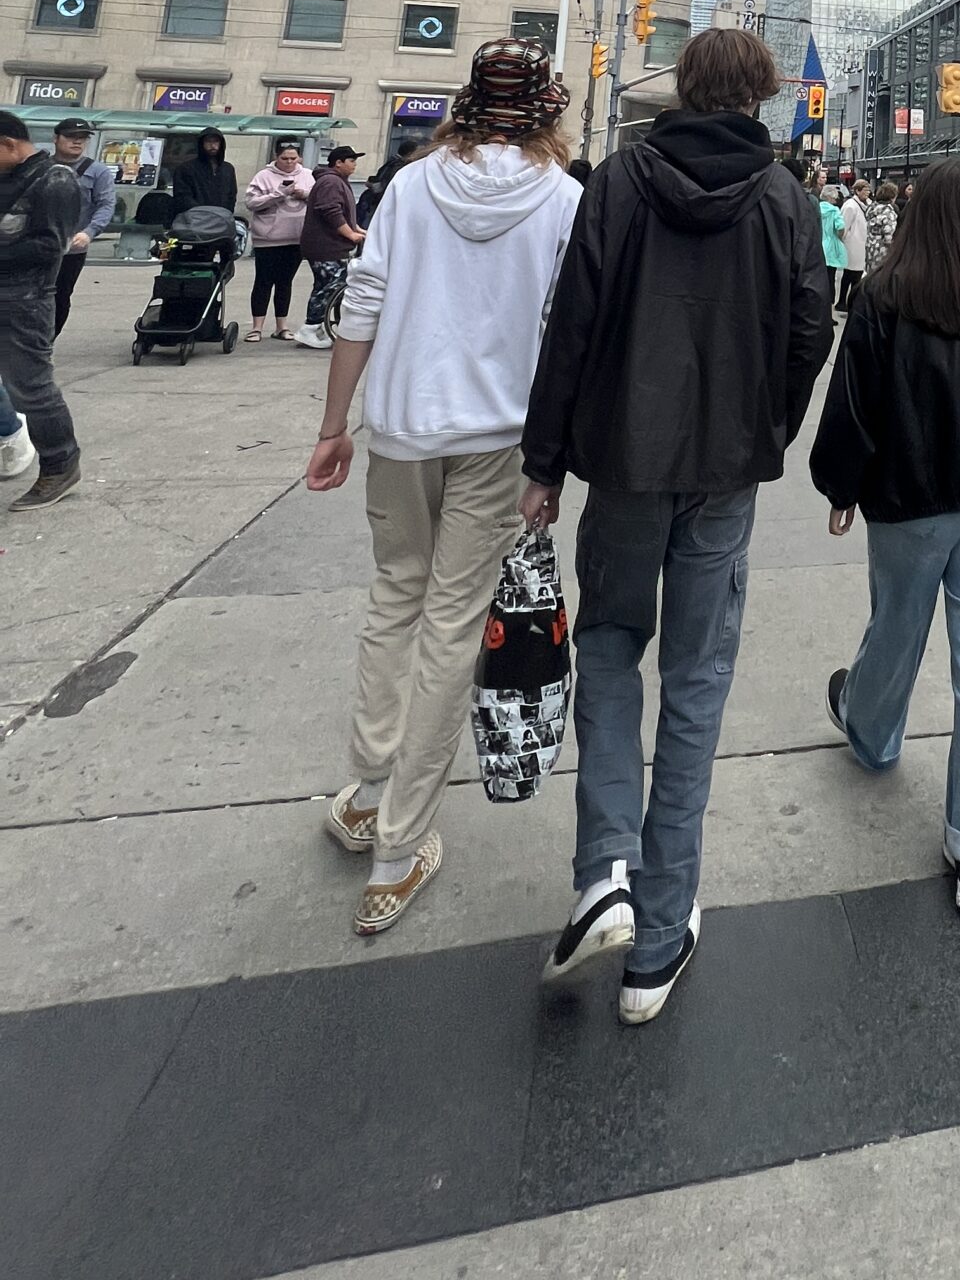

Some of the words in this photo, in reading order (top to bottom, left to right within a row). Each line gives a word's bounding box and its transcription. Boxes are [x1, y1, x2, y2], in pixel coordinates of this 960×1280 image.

[29, 83, 63, 99] fido
[169, 88, 207, 101] chatr
[291, 97, 329, 107] ROGERS
[407, 98, 441, 112] chatr
[866, 70, 877, 139] WINNERS
